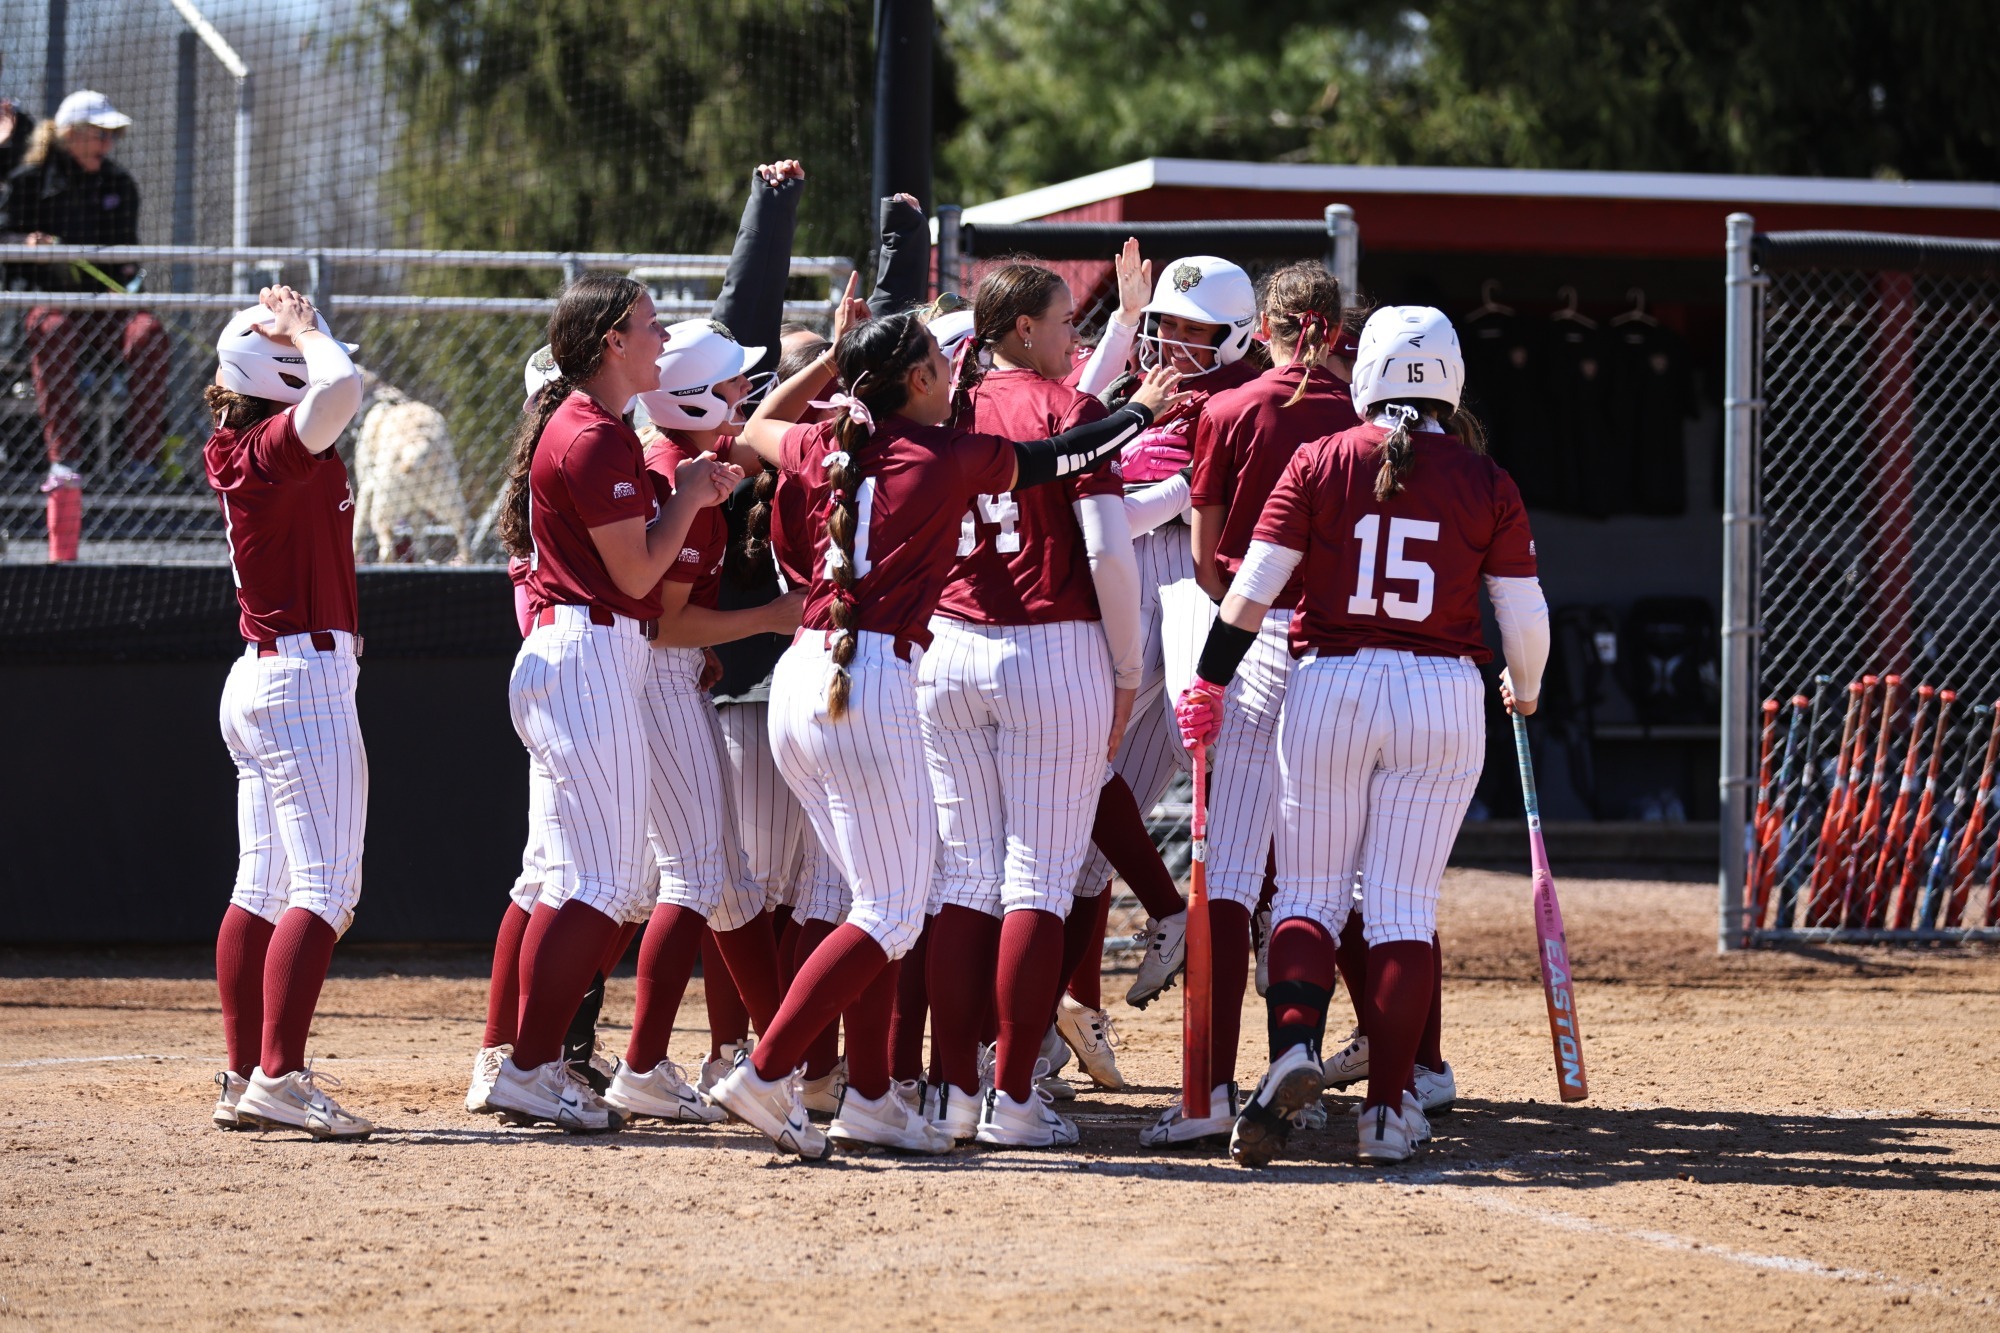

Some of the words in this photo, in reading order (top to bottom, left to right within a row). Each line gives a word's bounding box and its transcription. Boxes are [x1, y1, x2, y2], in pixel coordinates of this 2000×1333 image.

[1407, 363, 1424, 383] 15
[1348, 514, 1440, 622] 15
[1545, 938, 1582, 1089] EASTON
